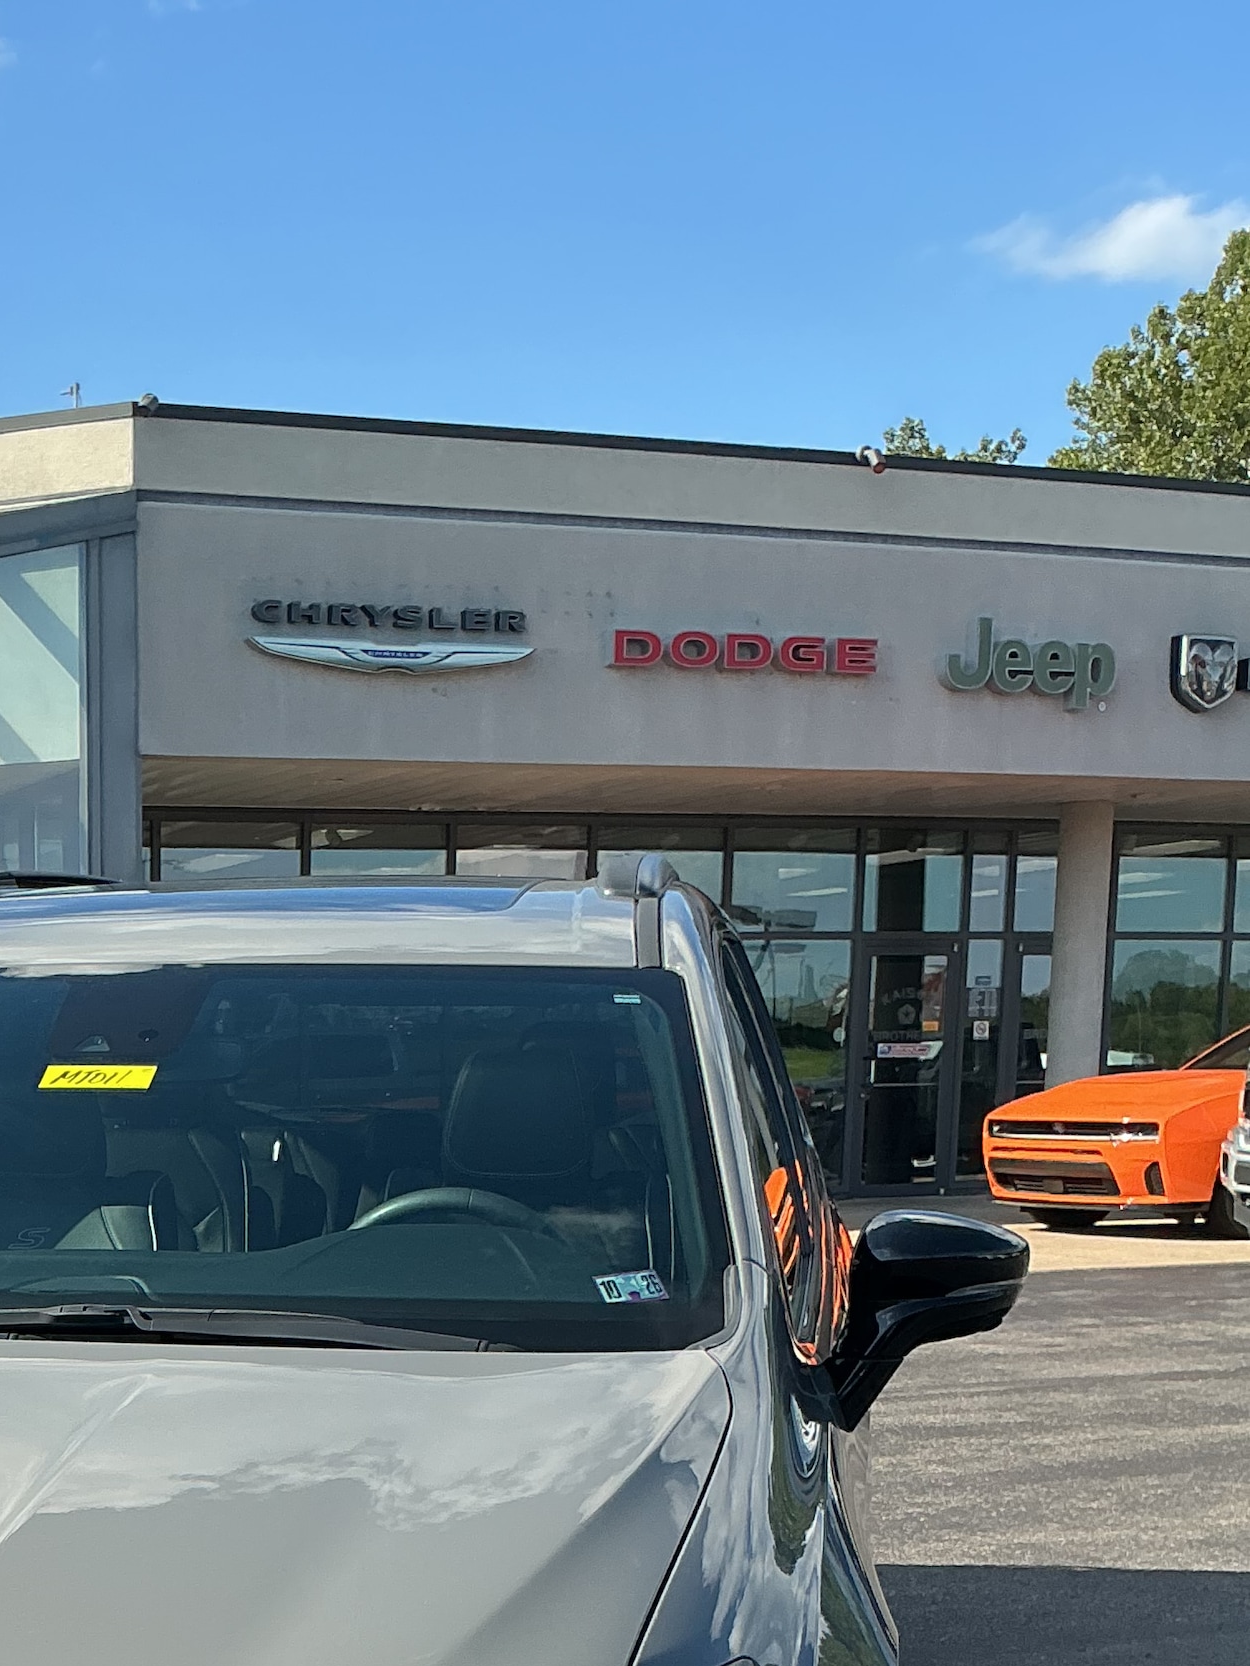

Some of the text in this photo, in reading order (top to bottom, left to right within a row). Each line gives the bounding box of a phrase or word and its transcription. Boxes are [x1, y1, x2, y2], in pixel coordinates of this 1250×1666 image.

[250, 599, 527, 633] CHRYSLER
[613, 629, 879, 674] DODGE
[946, 616, 1116, 710] Jeep
[8, 1226, 51, 1250] S
[599, 1274, 663, 1300] 10 26
